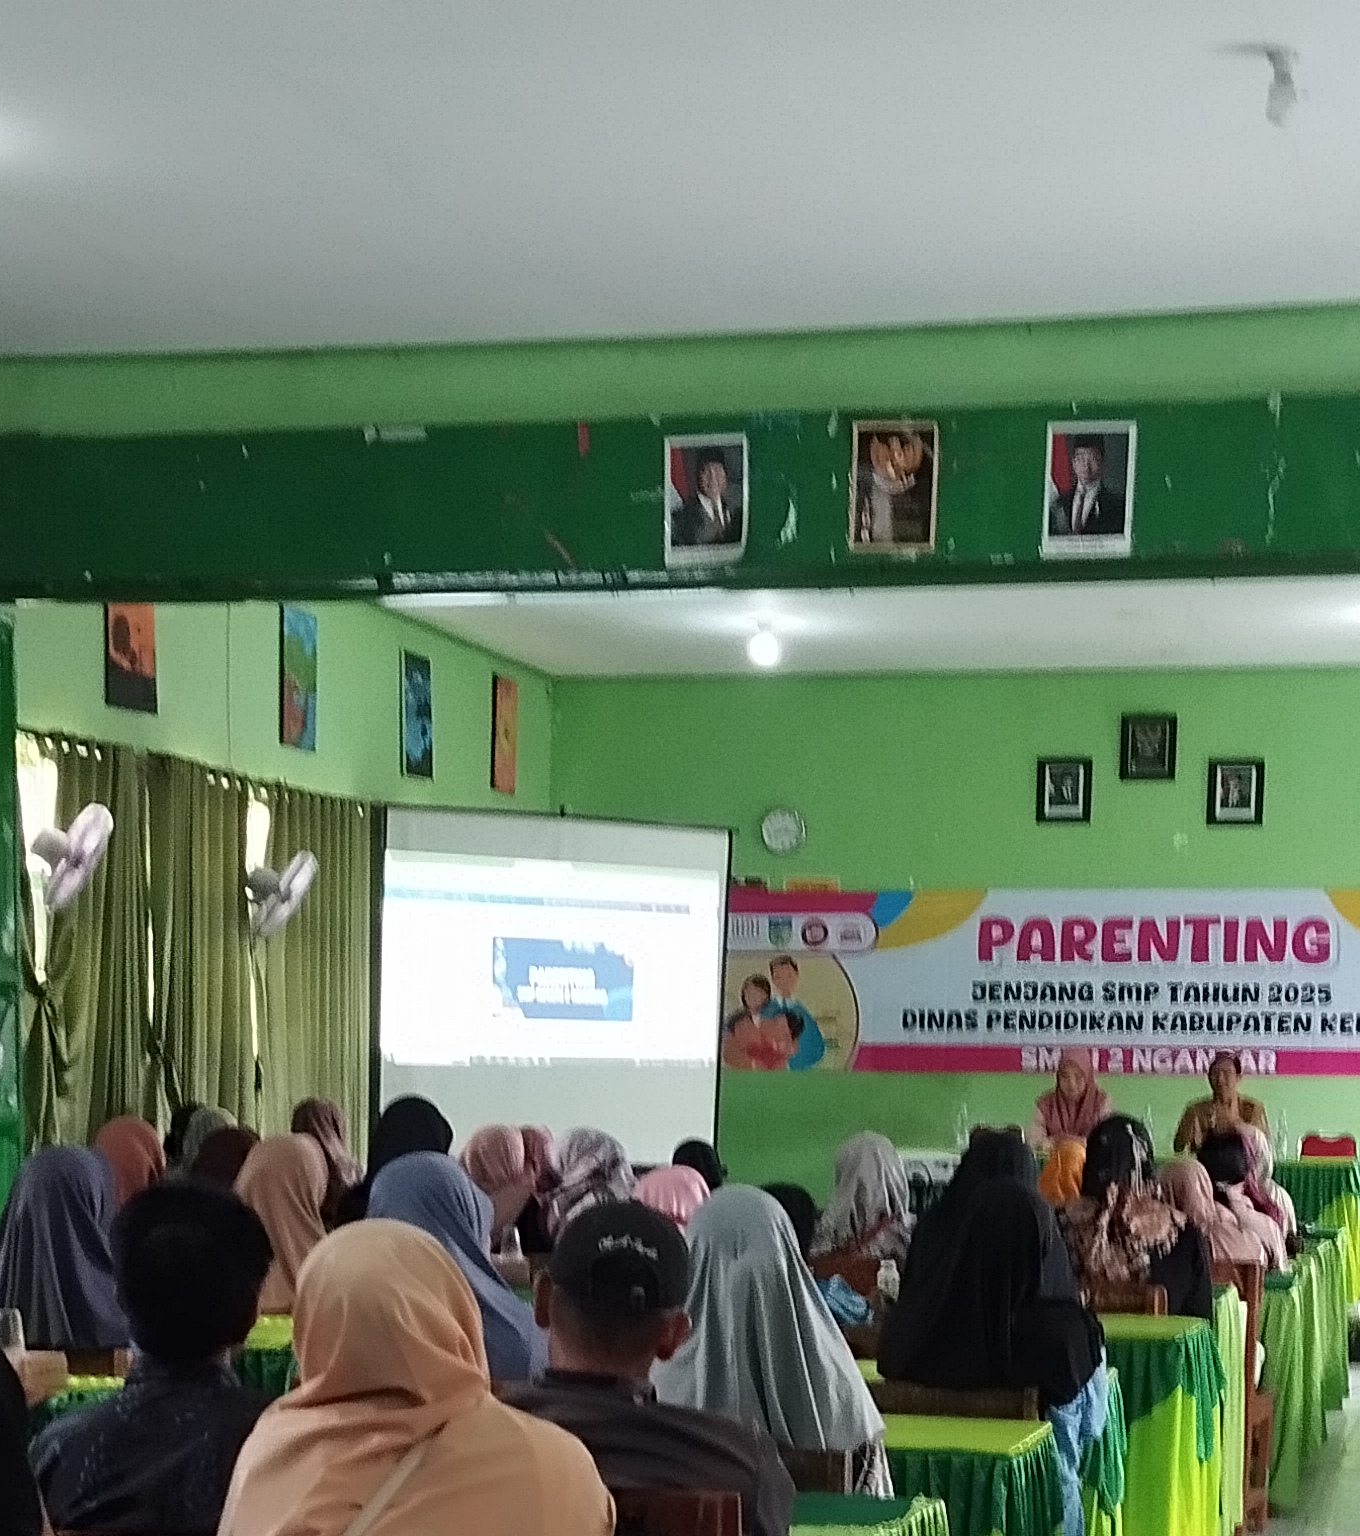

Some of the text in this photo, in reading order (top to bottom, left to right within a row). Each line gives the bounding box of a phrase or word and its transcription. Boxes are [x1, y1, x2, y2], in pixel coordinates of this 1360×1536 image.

[977, 915, 1331, 963] PARENTING
[971, 980, 1333, 1003] JENJANG SMP TAHUN 2025
[901, 1008, 979, 1031] DINAS
[986, 1009, 1144, 1032] PENDIDIKAN
[1152, 1011, 1312, 1034] KABUPATEN
[1132, 1048, 1278, 1075] NGANAR
